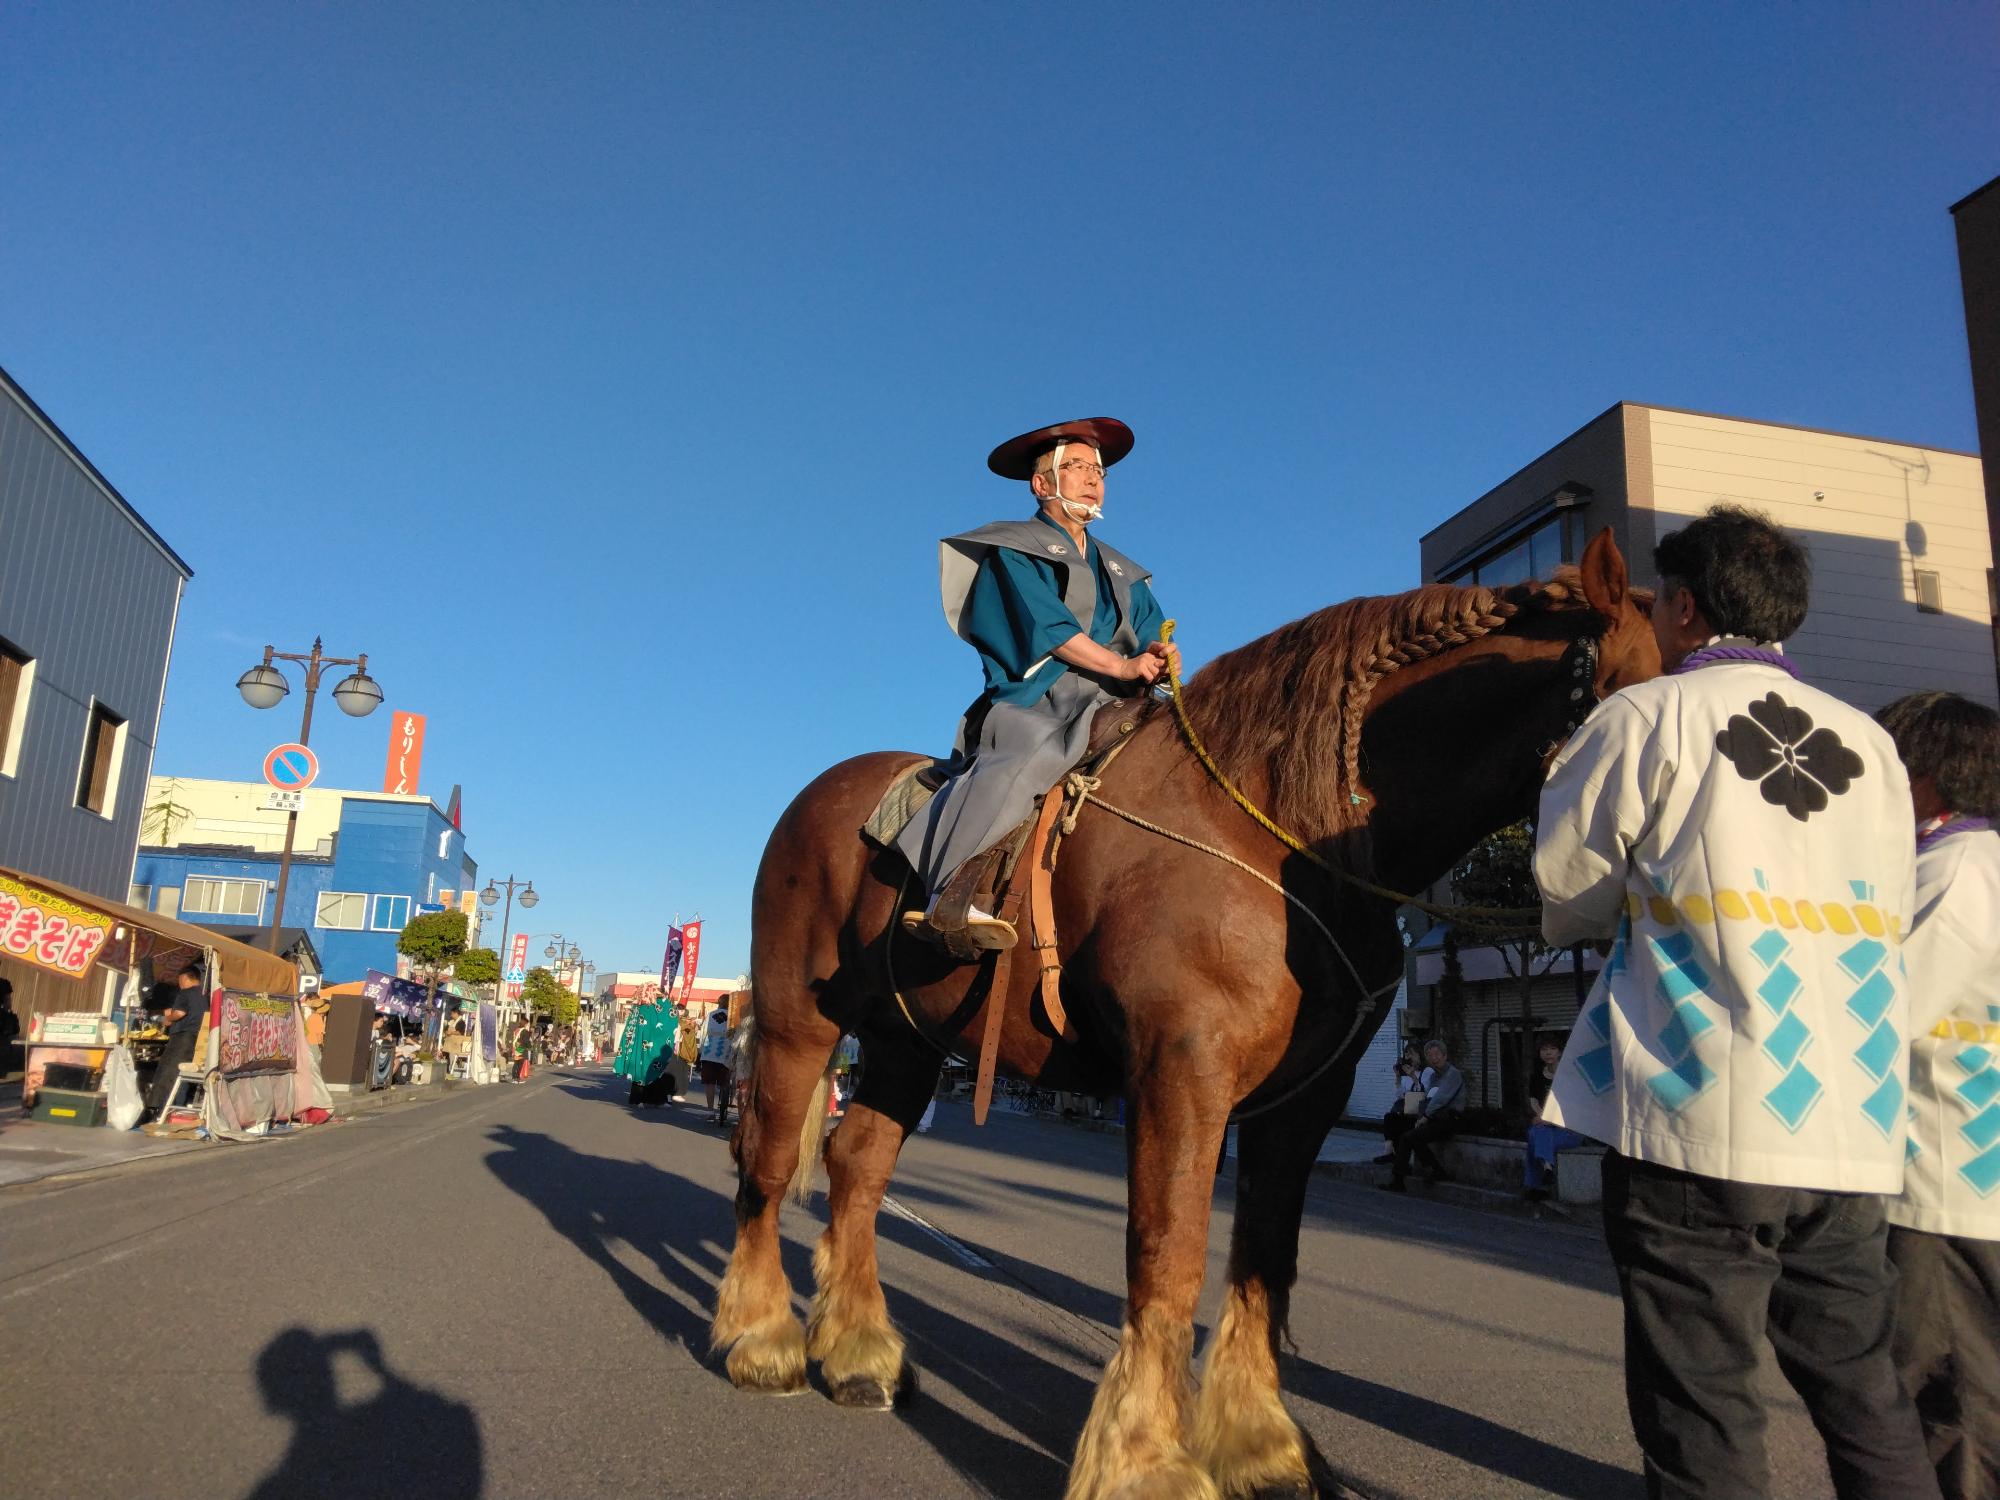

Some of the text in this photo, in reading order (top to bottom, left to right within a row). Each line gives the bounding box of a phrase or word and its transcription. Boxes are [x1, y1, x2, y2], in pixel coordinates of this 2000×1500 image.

[393, 716, 416, 795] もりしん
[270, 791, 302, 801] 自動車
[299, 975, 317, 993] P
